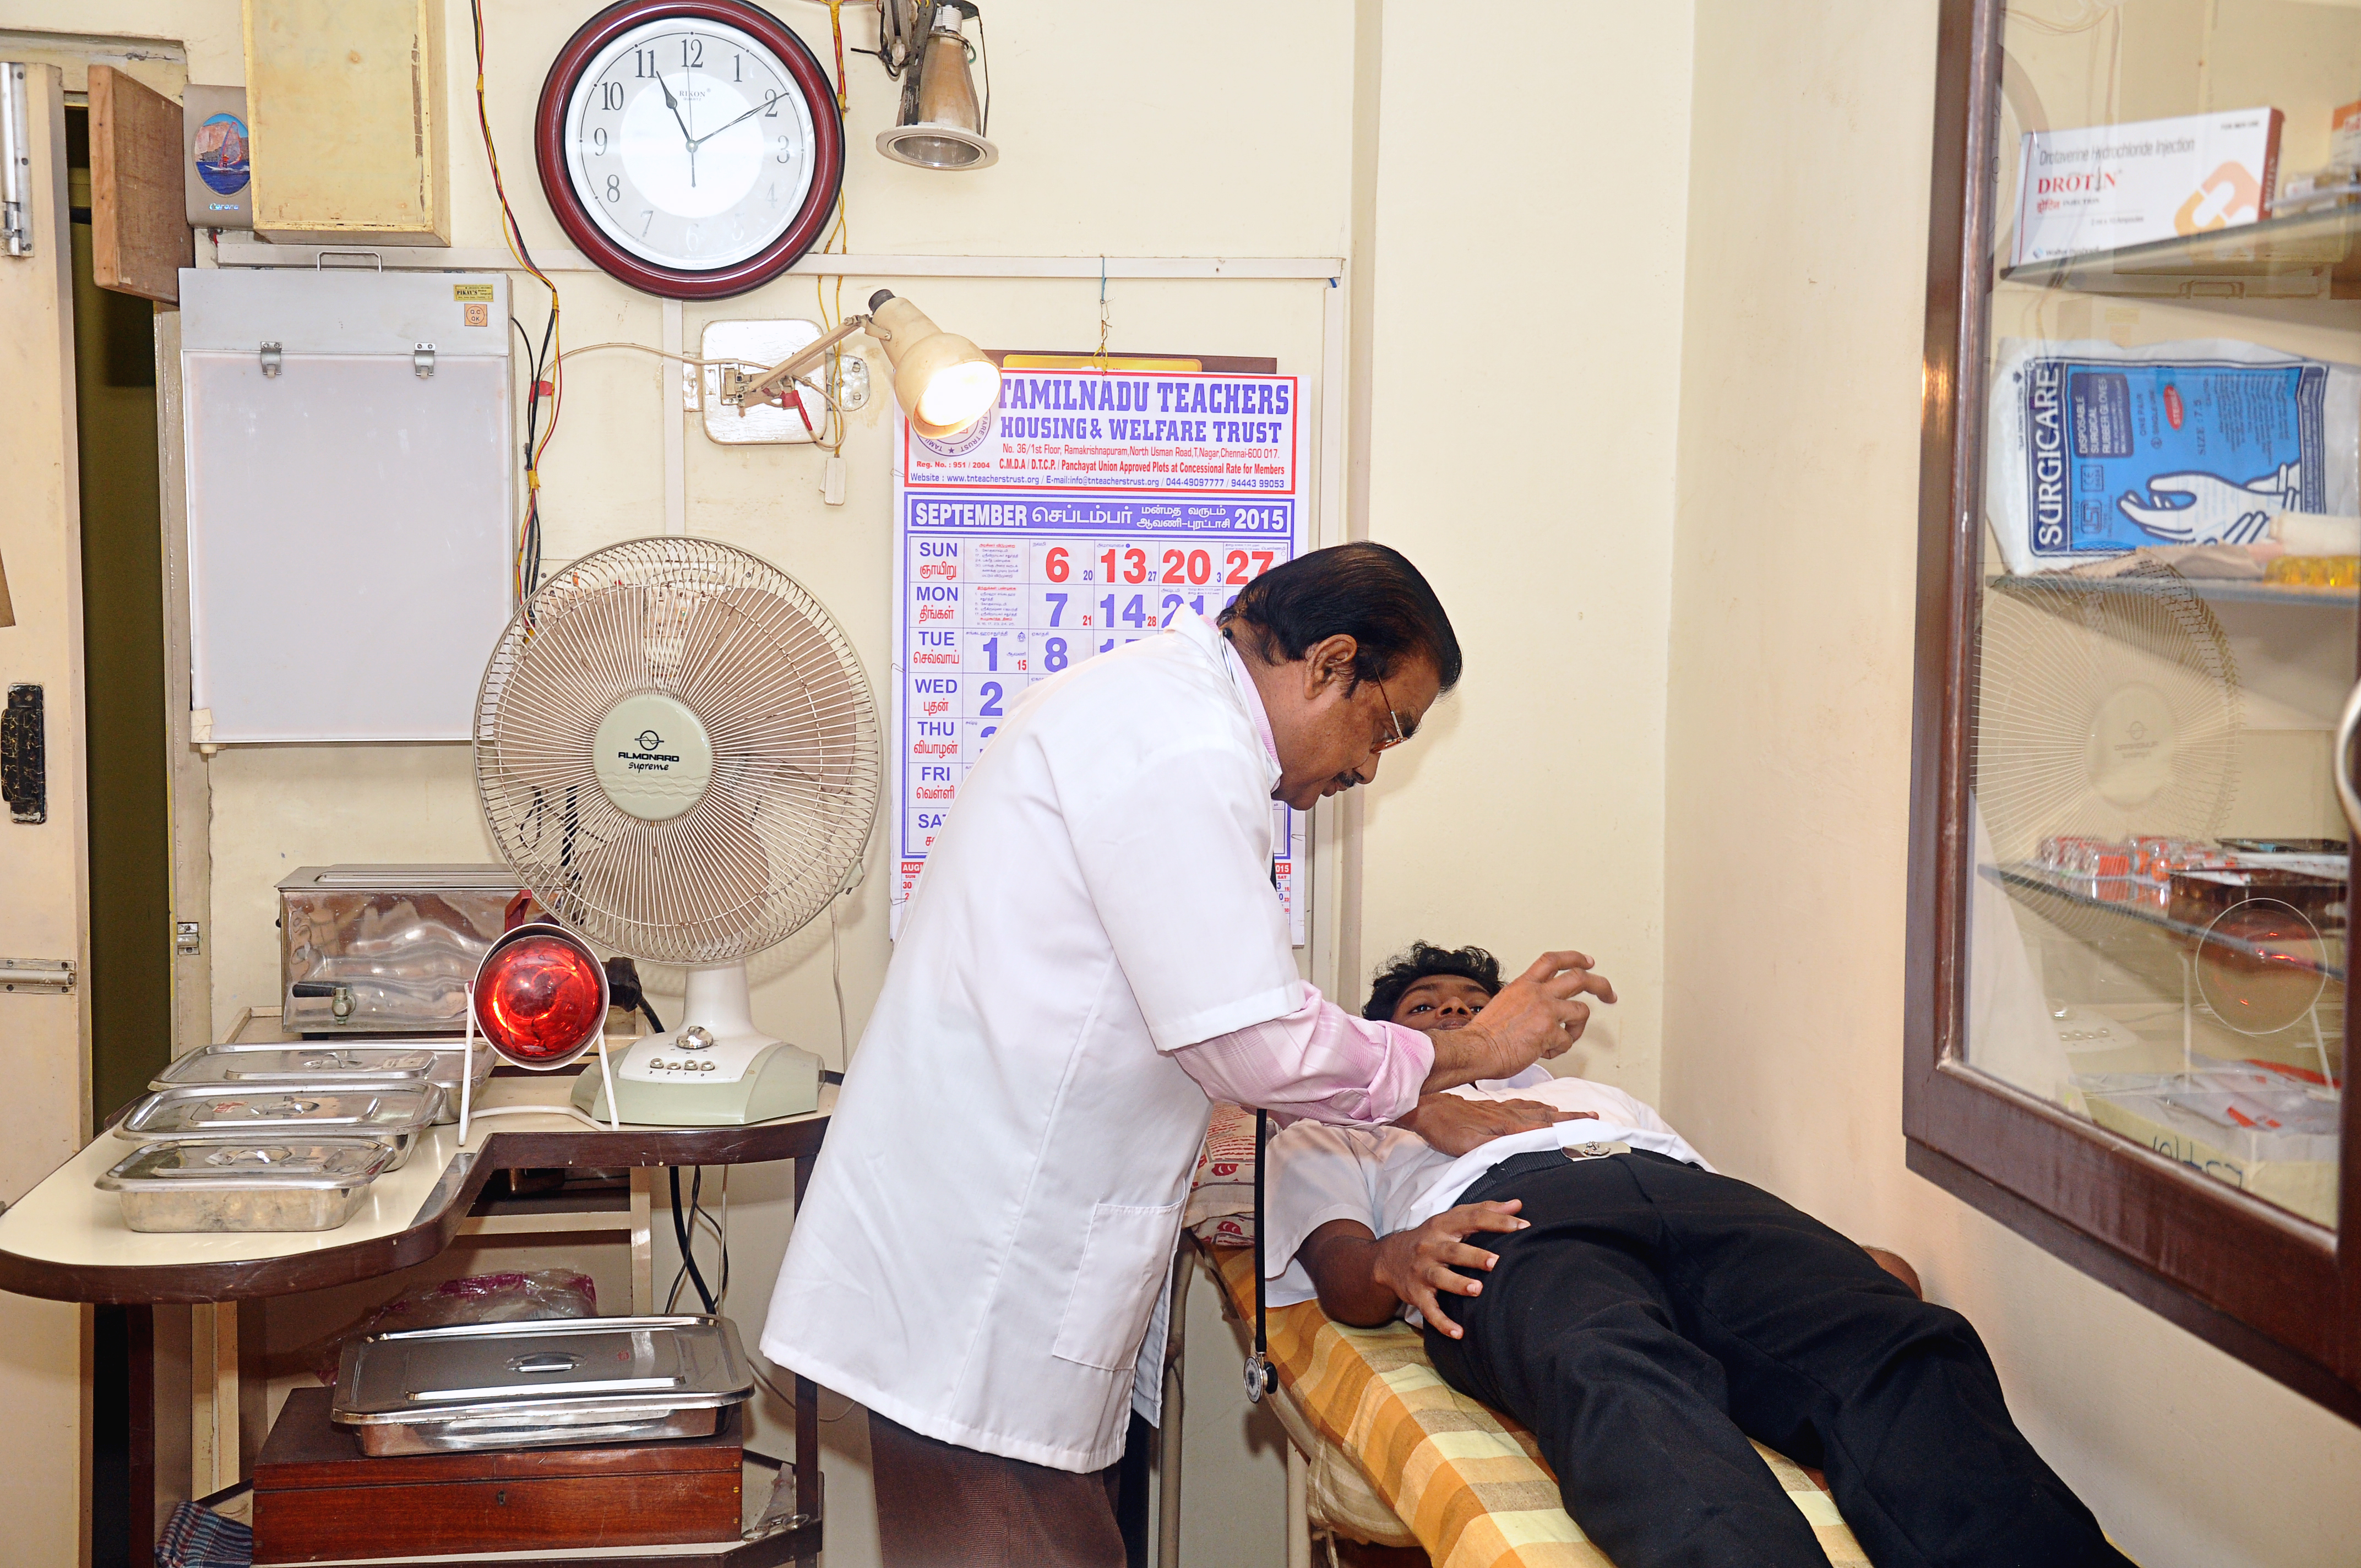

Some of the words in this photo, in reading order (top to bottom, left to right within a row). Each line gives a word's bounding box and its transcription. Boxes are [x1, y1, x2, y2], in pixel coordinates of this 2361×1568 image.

[635, 49, 658, 78] 11
[681, 39, 703, 68] 12
[734, 54, 742, 82] 1
[601, 82, 624, 110] 10
[765, 89, 777, 117] 2
[594, 128, 607, 156] 9
[777, 135, 790, 164] 3
[2156, 138, 2195, 157] Injection
[607, 175, 620, 203] 8
[765, 182, 778, 209] 4
[640, 210, 654, 237] 7
[998, 379, 1149, 412] TAMILNADU
[1157, 382, 1289, 415] TEACHERS
[2098, 378, 2109, 415] GLOVES
[1109, 418, 1206, 442] WELFARE
[1213, 421, 1282, 443] TRUST
[2075, 396, 2088, 454] DISPOSABLE
[2088, 407, 2099, 454] SURGICAL
[2100, 416, 2111, 454] RUBBER
[1003, 443, 1014, 454] No.
[1016, 444, 1042, 455] 36/1st
[1045, 444, 1062, 456] Floor,
[1151, 447, 1173, 458] Usman
[1264, 449, 1280, 459] 017.
[2035, 365, 2063, 546] SURGICARE
[917, 461, 933, 469] Reg.
[999, 458, 1026, 470] C.M.D.A
[1031, 459, 1056, 470] D.T.C.P.
[1062, 459, 1096, 473] Panchayat
[1098, 460, 1118, 471] Union
[1119, 461, 1150, 474] Approved
[1152, 462, 1169, 472] Plots
[1172, 464, 1178, 473] at
[1179, 462, 1224, 474] Concessional
[1226, 463, 1241, 474] Rate
[1243, 463, 1252, 474] for
[1254, 464, 1285, 475] Members
[911, 473, 939, 482] Website
[947, 475, 1039, 485] www.tnteacherstrust.org
[1259, 480, 1285, 488] 99053
[916, 502, 1027, 526] SEPTEMBER
[1032, 504, 1133, 524] செப்டம்பர்
[1141, 504, 1182, 517] மன்மத
[1188, 505, 1226, 518] வருடம்
[1234, 509, 1284, 530] 2015
[920, 542, 958, 557] SUN
[920, 561, 956, 580] ஞாயிறு
[1046, 547, 1069, 582] 6
[1101, 548, 1146, 584] 13
[1162, 549, 1211, 585] 20
[1226, 550, 1274, 585] 27
[1083, 570, 1093, 581] 20
[1148, 571, 1157, 581] 27
[1217, 572, 1221, 582] 3
[917, 586, 958, 601] MON
[919, 605, 954, 624] திங்கள்
[1046, 594, 1068, 627] 7
[1082, 615, 1092, 626] 21
[1100, 594, 1146, 628] 14
[1161, 594, 1204, 628] 21
[1147, 616, 1156, 627] 28
[918, 631, 955, 646] TUE
[913, 649, 959, 665] செவ்வாய்
[983, 638, 997, 671] 1
[1044, 637, 1068, 672] 8
[1017, 660, 1027, 671] 15
[915, 679, 958, 693] WED
[923, 698, 949, 716] புதன்
[980, 682, 1003, 716] 2
[917, 721, 955, 736] THU
[618, 752, 679, 762] ALMONARD
[914, 740, 958, 759] வியாழன்
[628, 762, 669, 773] supreme
[922, 766, 950, 781] FRI
[916, 785, 955, 799] வெள்ளி
[1276, 864, 1289, 873] 015
